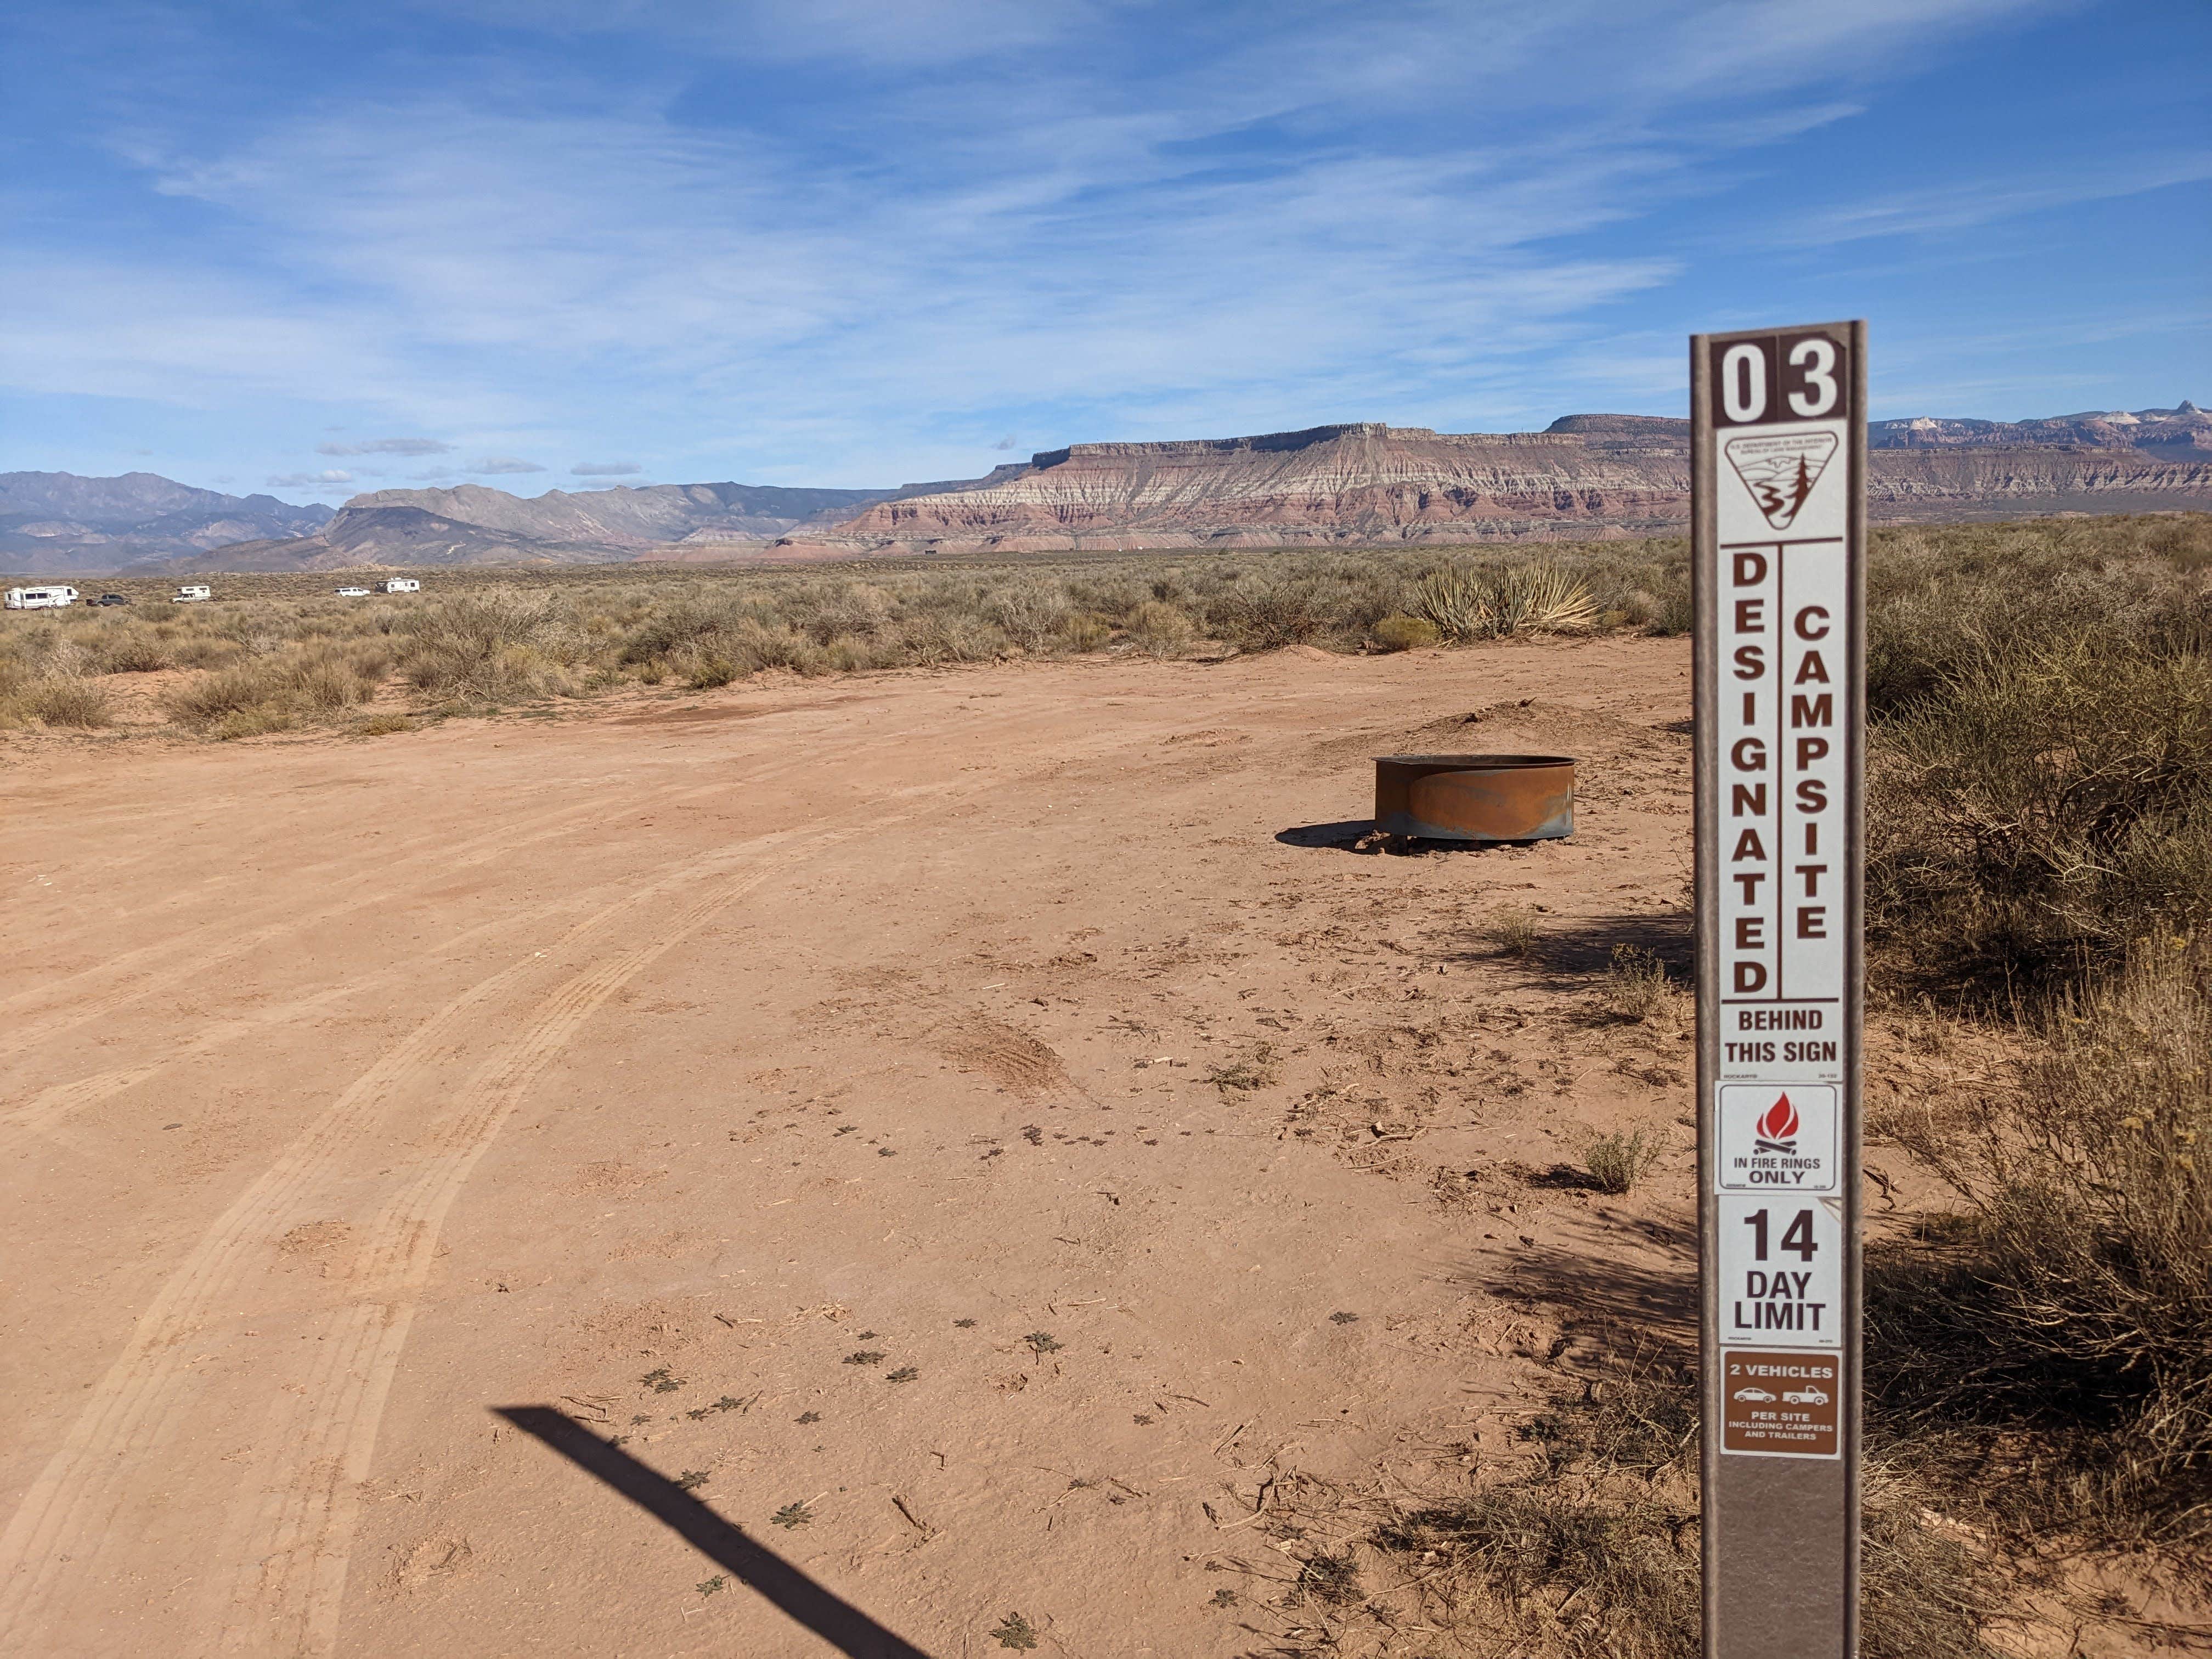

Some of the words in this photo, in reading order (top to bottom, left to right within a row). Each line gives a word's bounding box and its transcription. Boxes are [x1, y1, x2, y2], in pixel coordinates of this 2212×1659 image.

[1731, 552, 1767, 993] DESIGNATED
[1791, 606, 1832, 939] CAMPSITE
[1738, 1009, 1823, 1031] BEHIND
[1725, 1042, 1776, 1063] THIS
[1783, 1041, 1837, 1062] SIGN
[1734, 1158, 1747, 1169] IN
[1751, 1158, 1777, 1169] FIRE
[1781, 1158, 1821, 1170] RINGS
[1749, 1171, 1805, 1184] ONLY
[1744, 1209, 1818, 1262] 14
[1747, 1271, 1812, 1300] DAY
[1735, 1301, 1826, 1331] LIMIT
[1730, 1364, 1740, 1375] 2
[1745, 1364, 1833, 1379] VEHICLES
[1729, 1421, 1782, 1430] INCLUDING
[1785, 1424, 1833, 1432] CAMPERS
[1751, 1411, 1776, 1420] PER
[1781, 1412, 1810, 1422] SITE
[1768, 1431, 1816, 1440] TRAILERS
